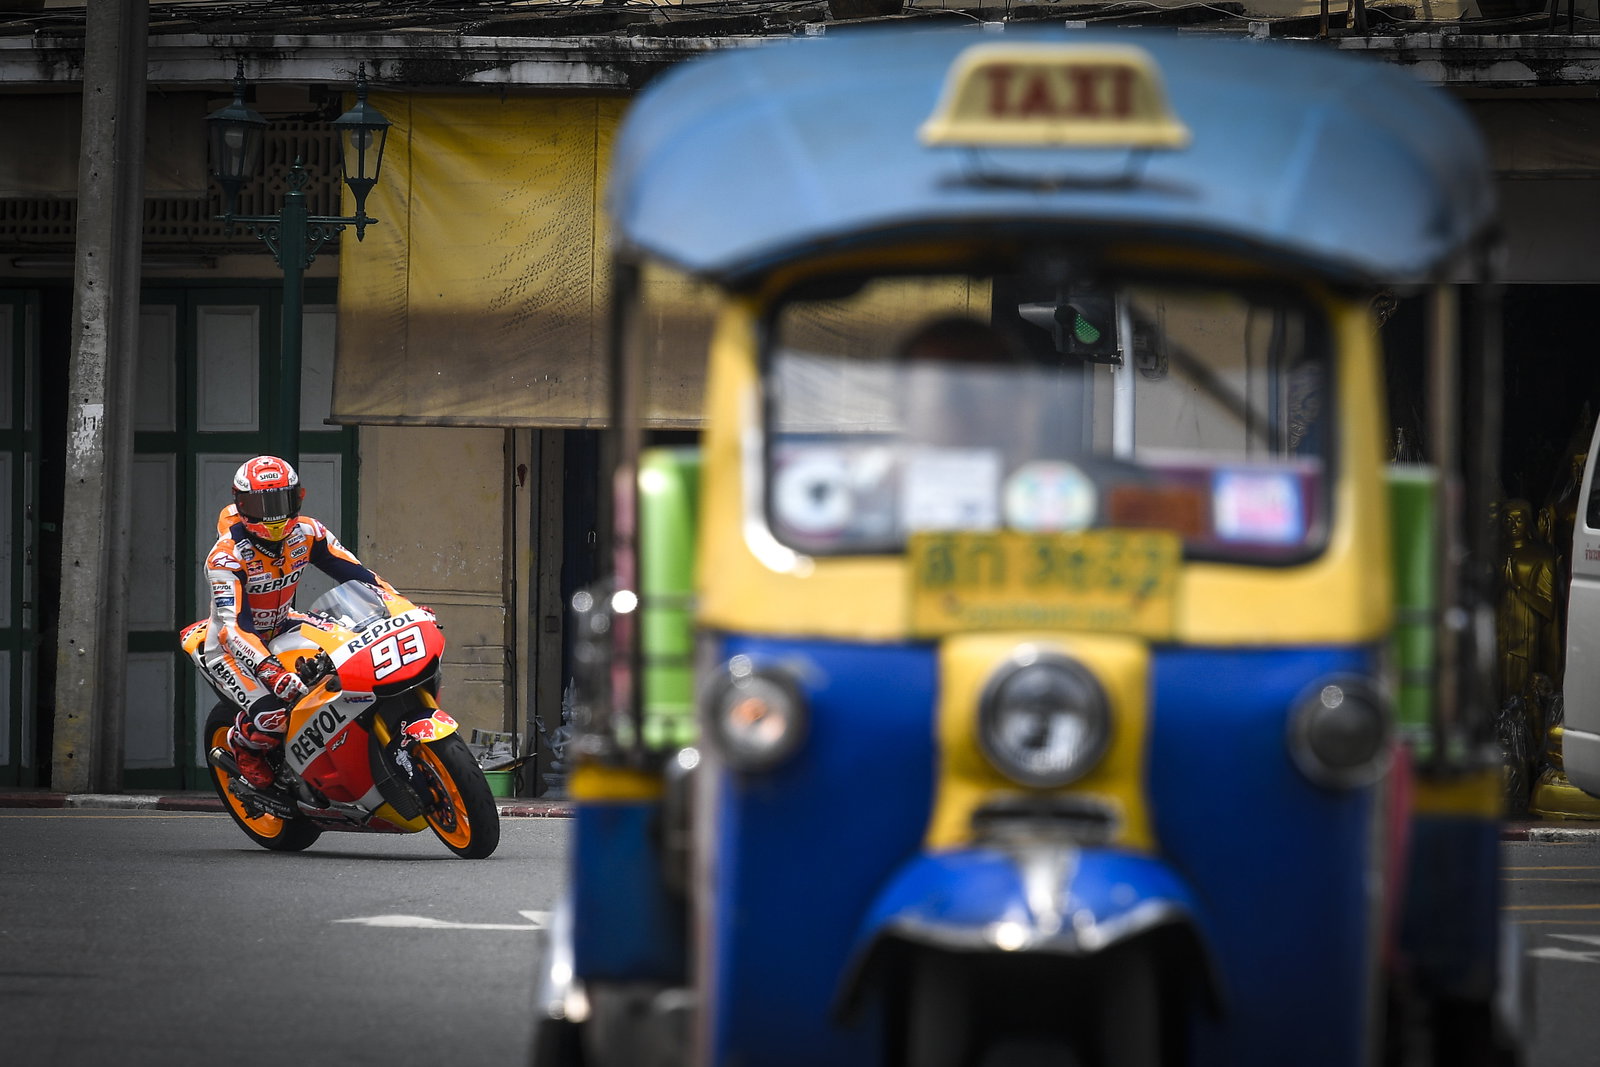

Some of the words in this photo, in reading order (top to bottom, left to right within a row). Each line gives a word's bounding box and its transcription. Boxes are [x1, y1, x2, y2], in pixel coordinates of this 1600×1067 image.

[985, 61, 1135, 120] TAXI
[259, 472, 279, 481] SHOEI
[255, 543, 276, 558] REPSOL
[347, 613, 415, 654] REPSOL
[370, 625, 427, 680] 93
